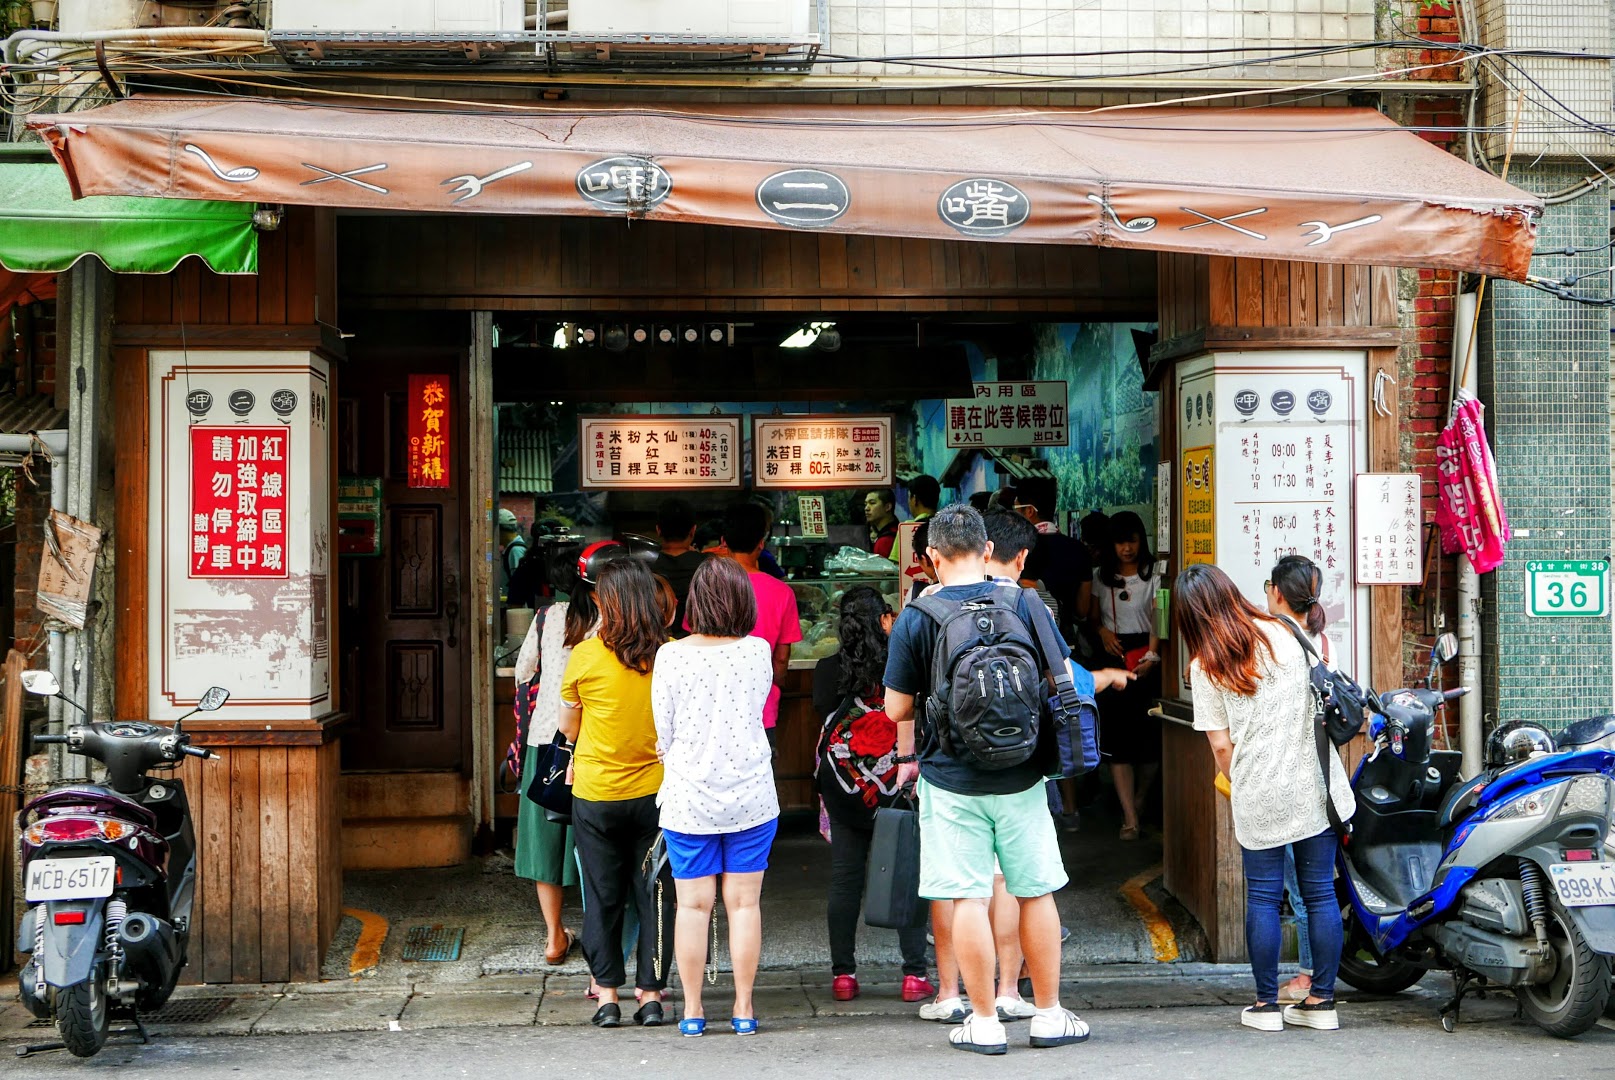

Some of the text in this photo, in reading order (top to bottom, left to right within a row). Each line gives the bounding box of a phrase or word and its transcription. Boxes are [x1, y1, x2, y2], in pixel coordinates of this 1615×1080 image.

[951, 404, 1064, 430] 請在此等候帶位
[422, 381, 445, 480] 恭賀新禧
[699, 428, 717, 439] 40元
[771, 427, 849, 440] 外帶區請排隊
[963, 432, 983, 442] 入口
[1034, 431, 1053, 441] 出口
[609, 430, 622, 476] 米苔目
[646, 430, 659, 475] 大紅豆
[664, 430, 678, 475] 仙草
[699, 441, 717, 452] 45元
[766, 445, 802, 460] 米苔目
[865, 447, 881, 459] 20元
[1272, 443, 1296, 457] 09:00
[699, 453, 717, 464] 50元
[699, 466, 717, 477] 55元
[809, 461, 831, 475] 60元
[865, 462, 881, 473] 20元
[1273, 474, 1297, 488] 17:30
[211, 436, 232, 570] 請勿停車
[236, 435, 257, 570] 加強取締中
[261, 436, 283, 570] 紅線區域
[194, 513, 209, 570] 謝謝!
[1530, 562, 1543, 571] 34
[1591, 562, 1604, 571] 38
[1547, 582, 1587, 608] 36
